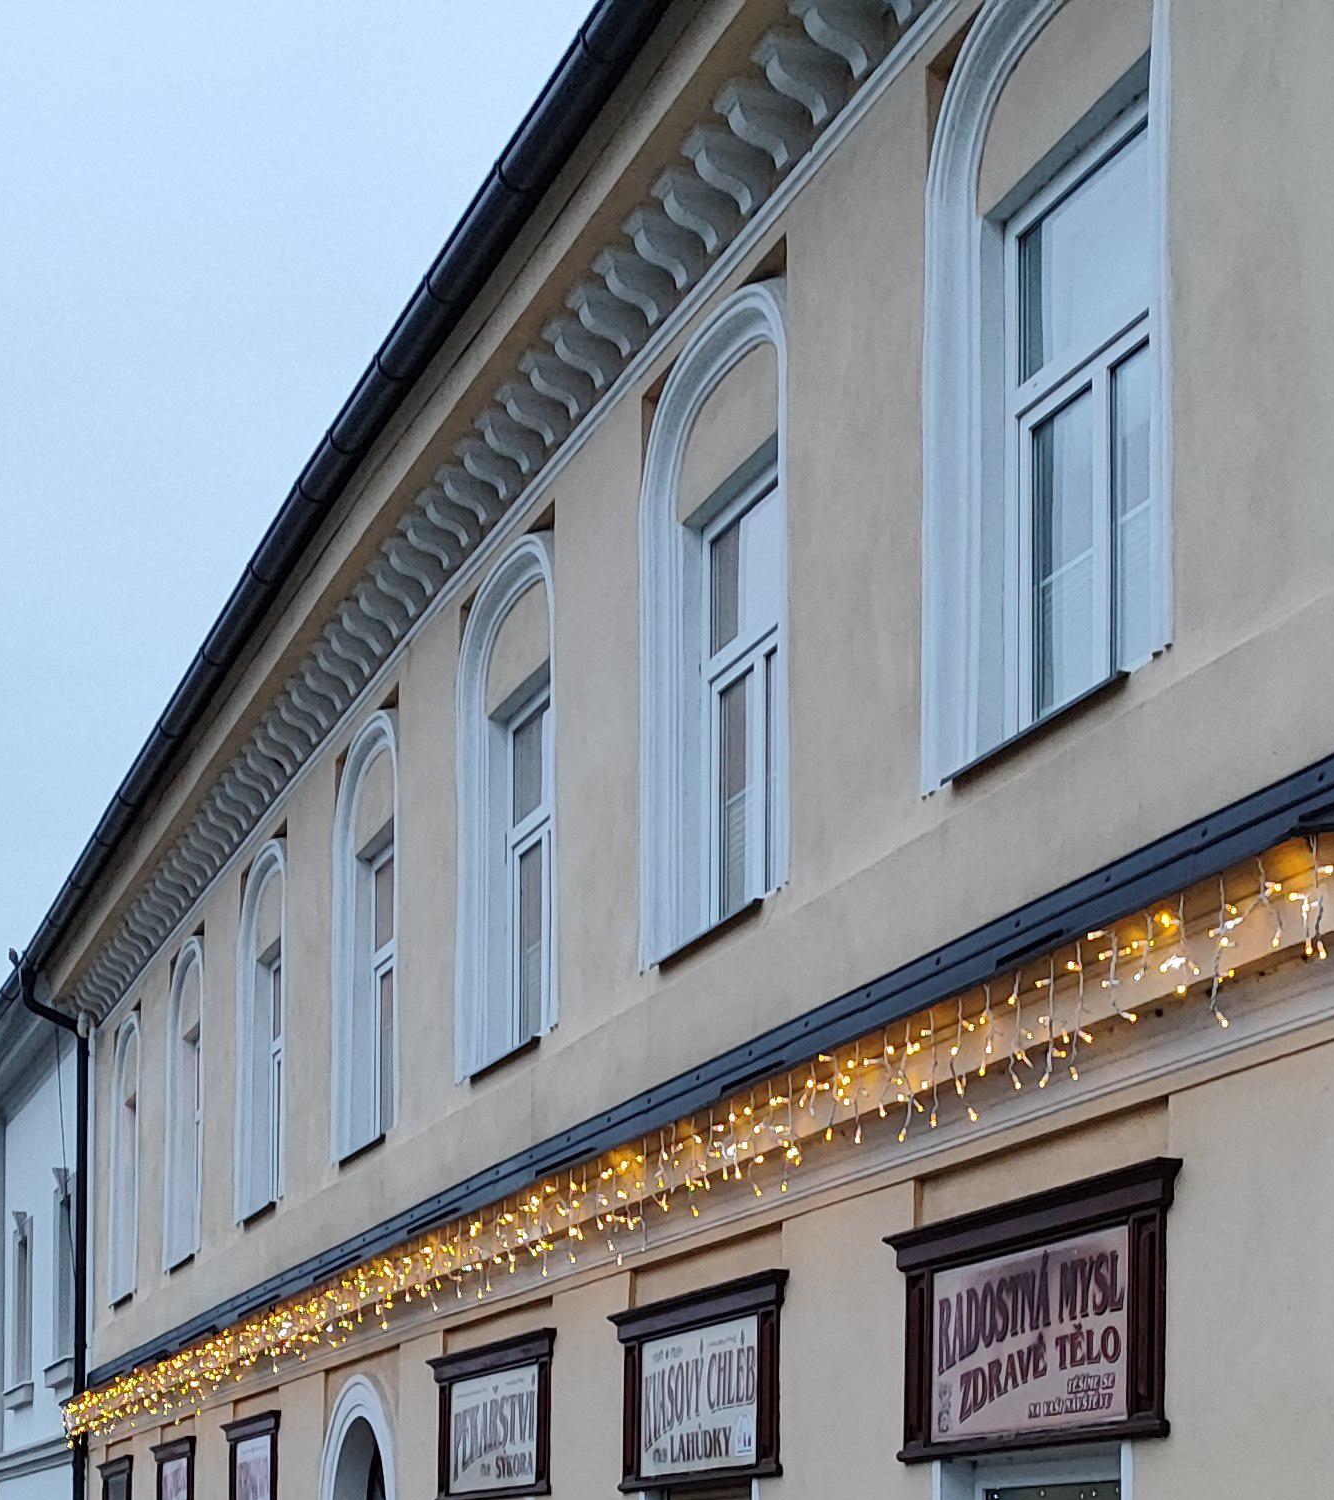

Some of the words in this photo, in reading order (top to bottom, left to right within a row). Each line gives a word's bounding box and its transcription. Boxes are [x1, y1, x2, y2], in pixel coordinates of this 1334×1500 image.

[937, 1250, 1052, 1376] RADOSTNÁ
[958, 1331, 1048, 1424] ZDRAVÉ
[1055, 1323, 1122, 1371] TĚLO
[643, 1338, 704, 1453] KVASOVÝ
[707, 1329, 756, 1413] CHLÉB
